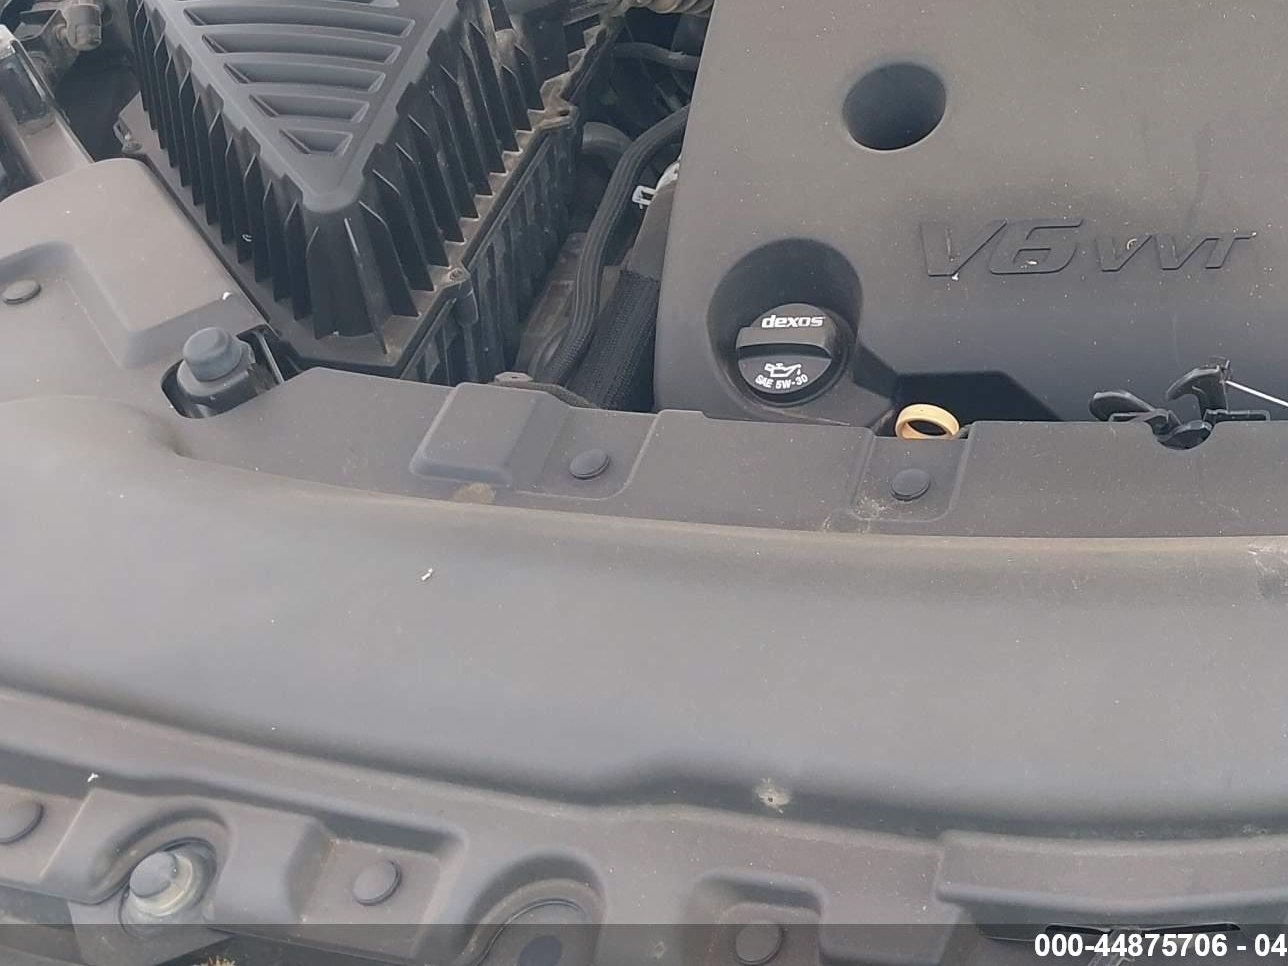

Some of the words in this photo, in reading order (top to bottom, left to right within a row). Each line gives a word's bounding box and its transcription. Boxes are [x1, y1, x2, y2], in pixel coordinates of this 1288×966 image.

[920, 217, 1084, 277] V6
[1094, 232, 1257, 272] VVT
[761, 314, 826, 329] dexos
[755, 374, 775, 389] SAE
[775, 373, 809, 390] 5W-30
